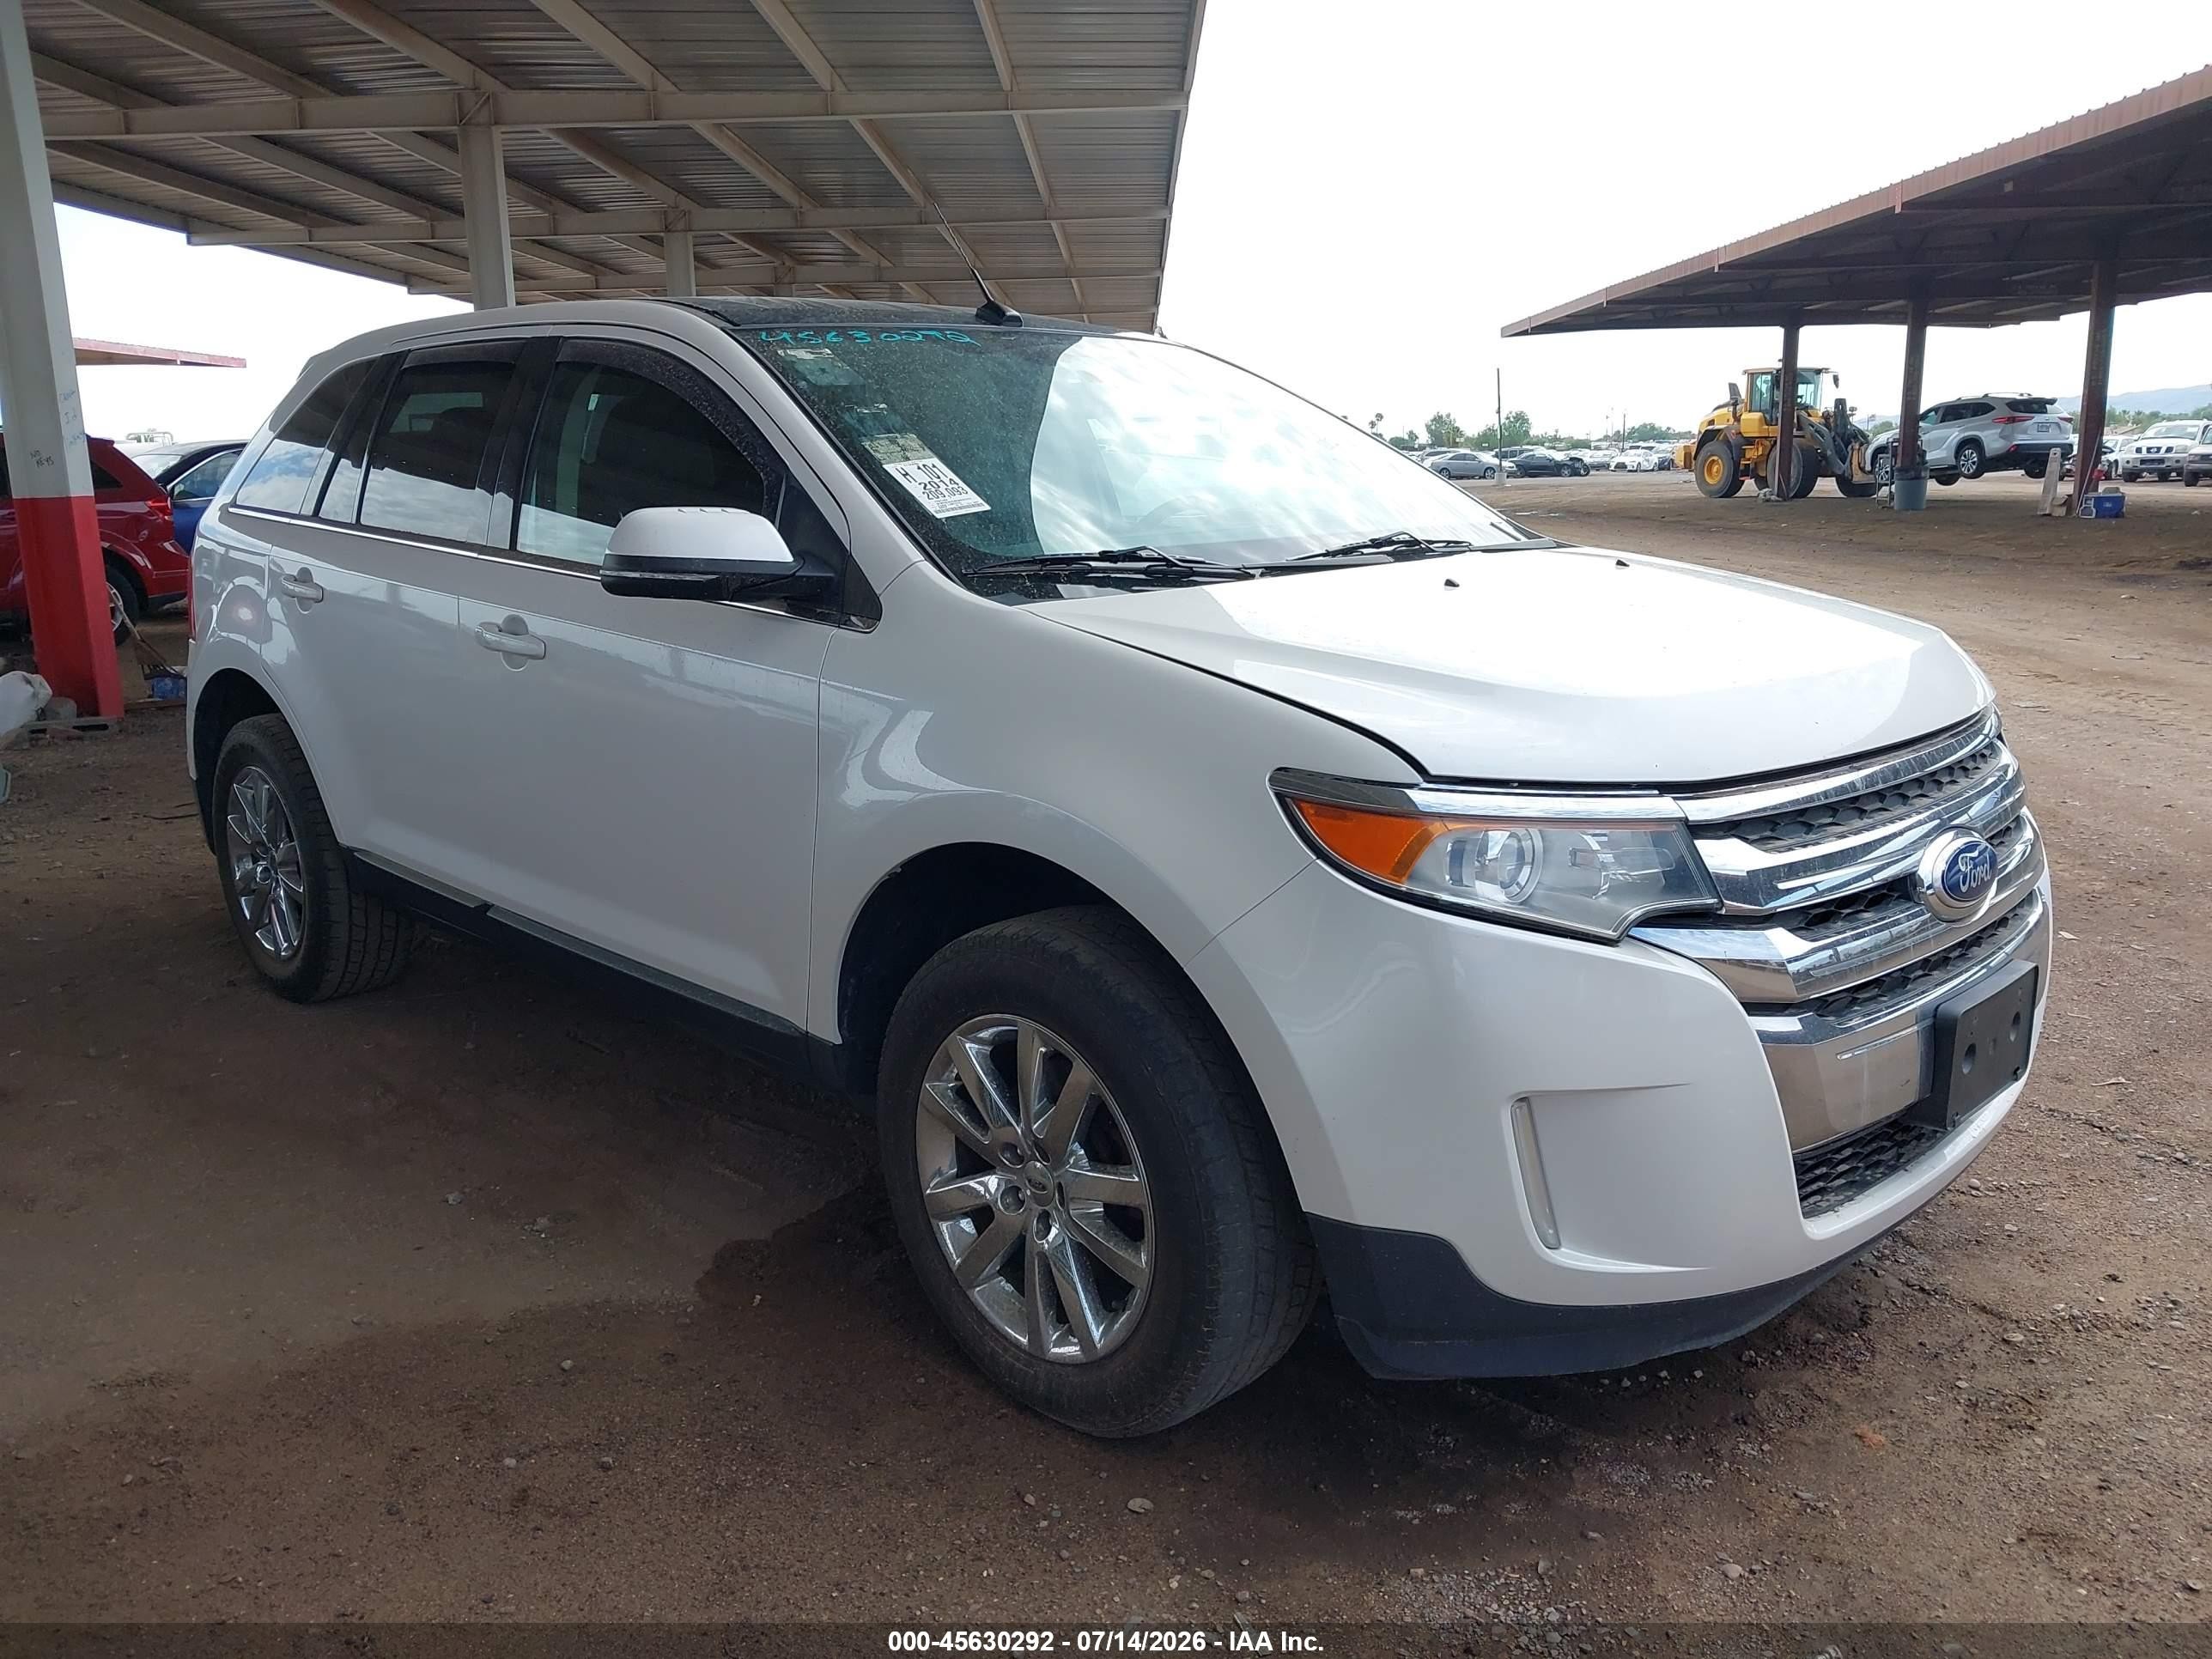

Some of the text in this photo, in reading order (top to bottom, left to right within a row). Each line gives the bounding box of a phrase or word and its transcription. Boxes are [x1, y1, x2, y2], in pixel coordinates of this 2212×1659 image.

[895, 463, 948, 483] H 101
[918, 477, 959, 491] 2014
[922, 486, 969, 501] 209,093
[1958, 845, 1992, 893] Ford
